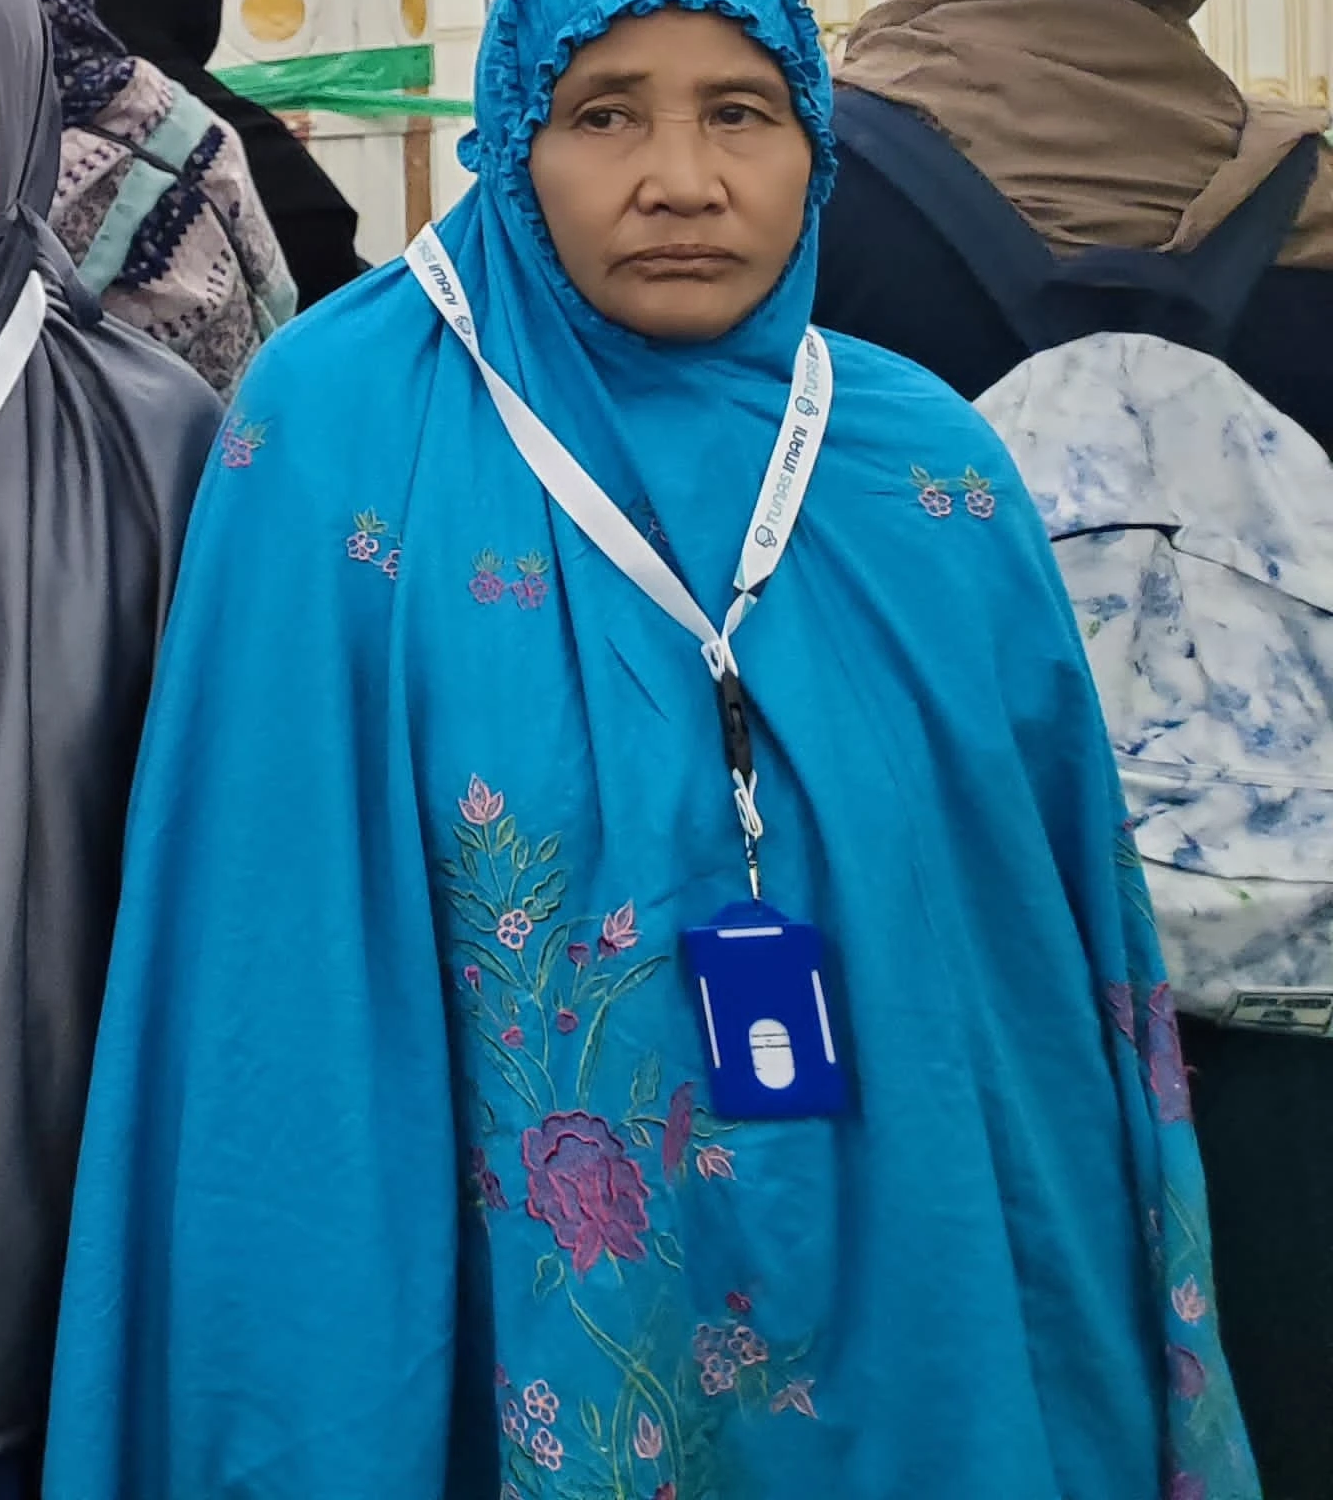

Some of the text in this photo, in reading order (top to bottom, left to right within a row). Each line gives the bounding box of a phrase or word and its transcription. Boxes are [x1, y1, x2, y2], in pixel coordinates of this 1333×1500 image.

[427, 262, 458, 307] IMANI
[766, 473, 794, 525] TUNAS
[784, 426, 807, 474] IMANI
